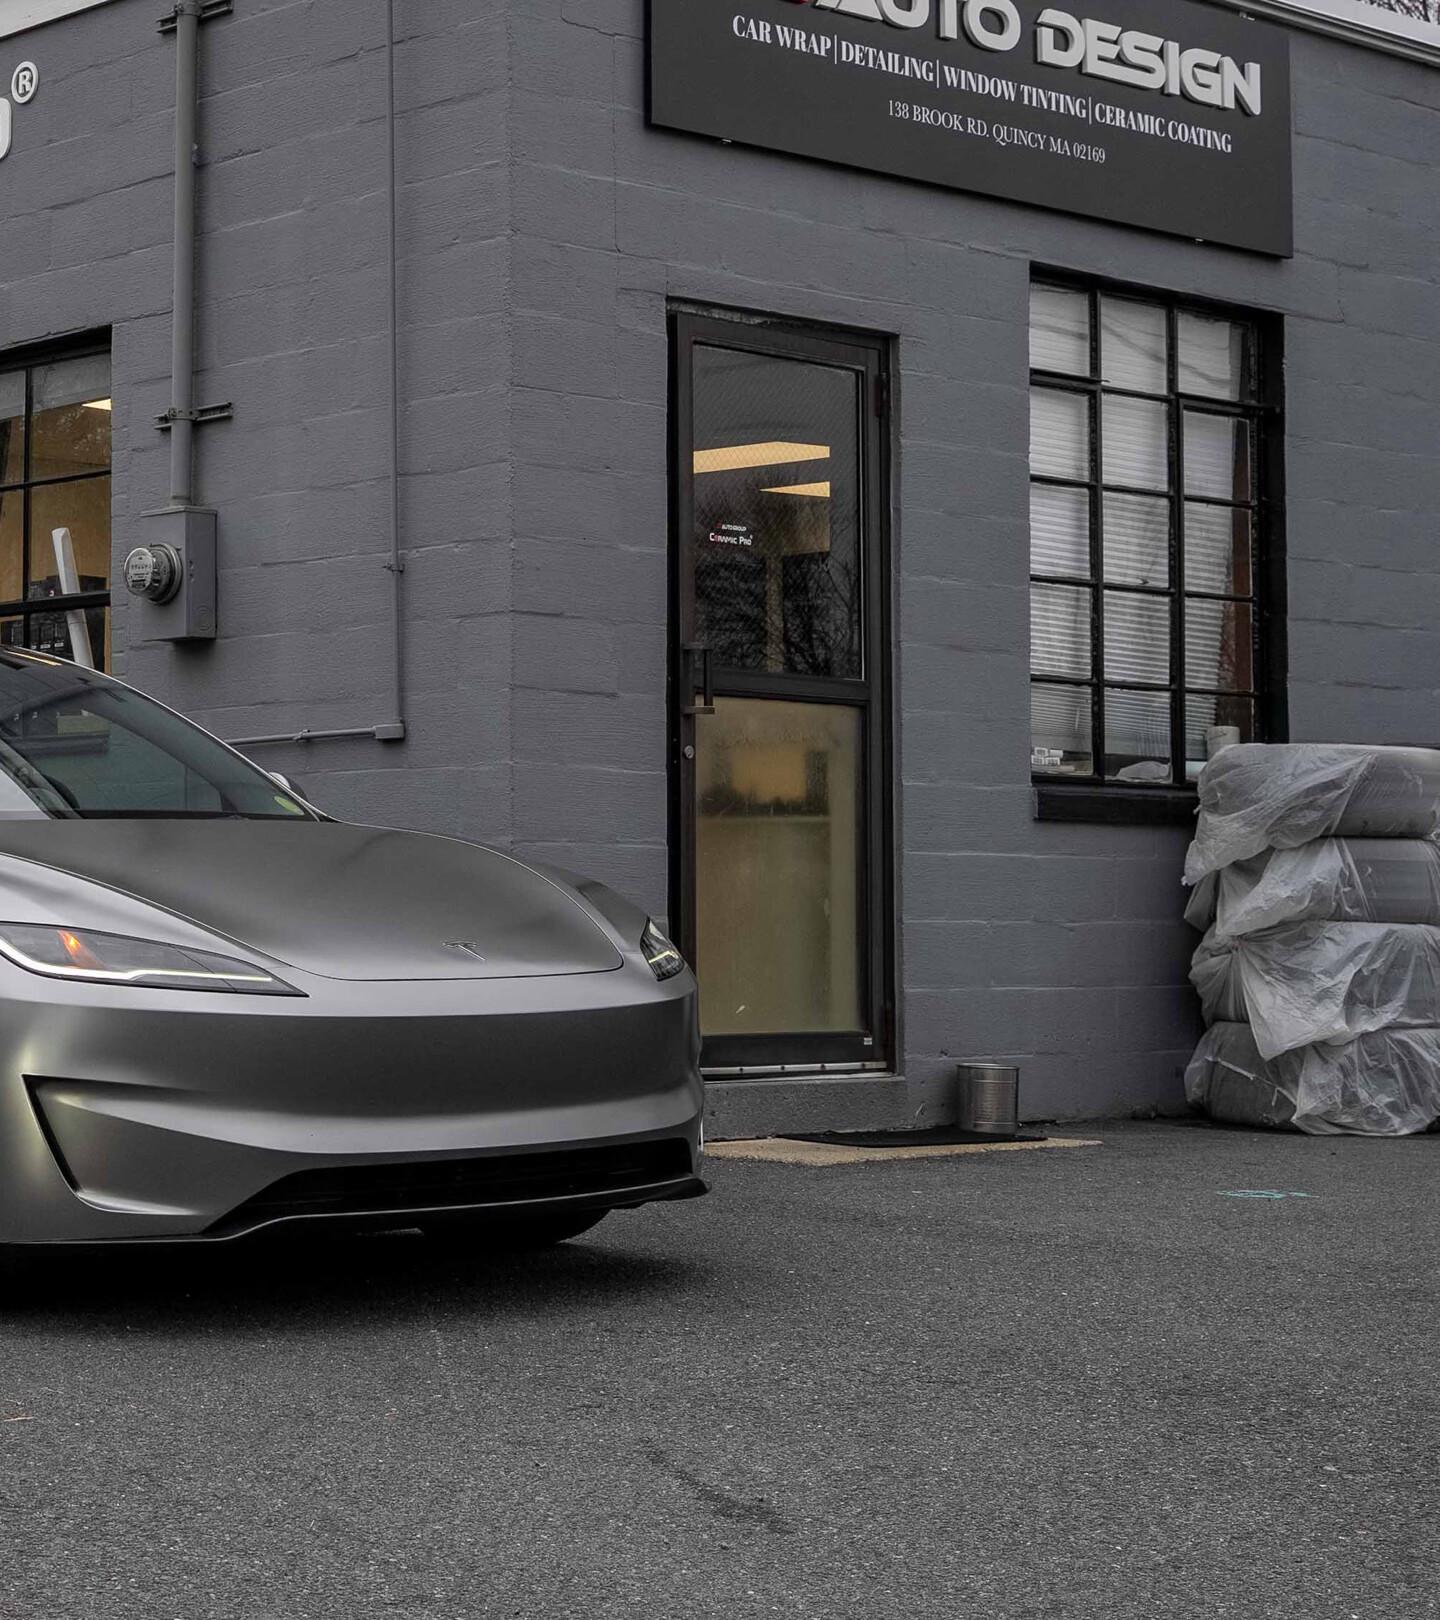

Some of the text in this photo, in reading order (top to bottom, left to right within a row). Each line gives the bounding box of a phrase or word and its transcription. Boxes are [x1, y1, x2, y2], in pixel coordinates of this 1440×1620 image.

[732, 15, 772, 44] CAR
[1167, 120, 1233, 153] COATING
[1036, 8, 1261, 116] DESIGN
[888, 100, 1106, 164] 138 BROOK RD. QUINCY MA 02169
